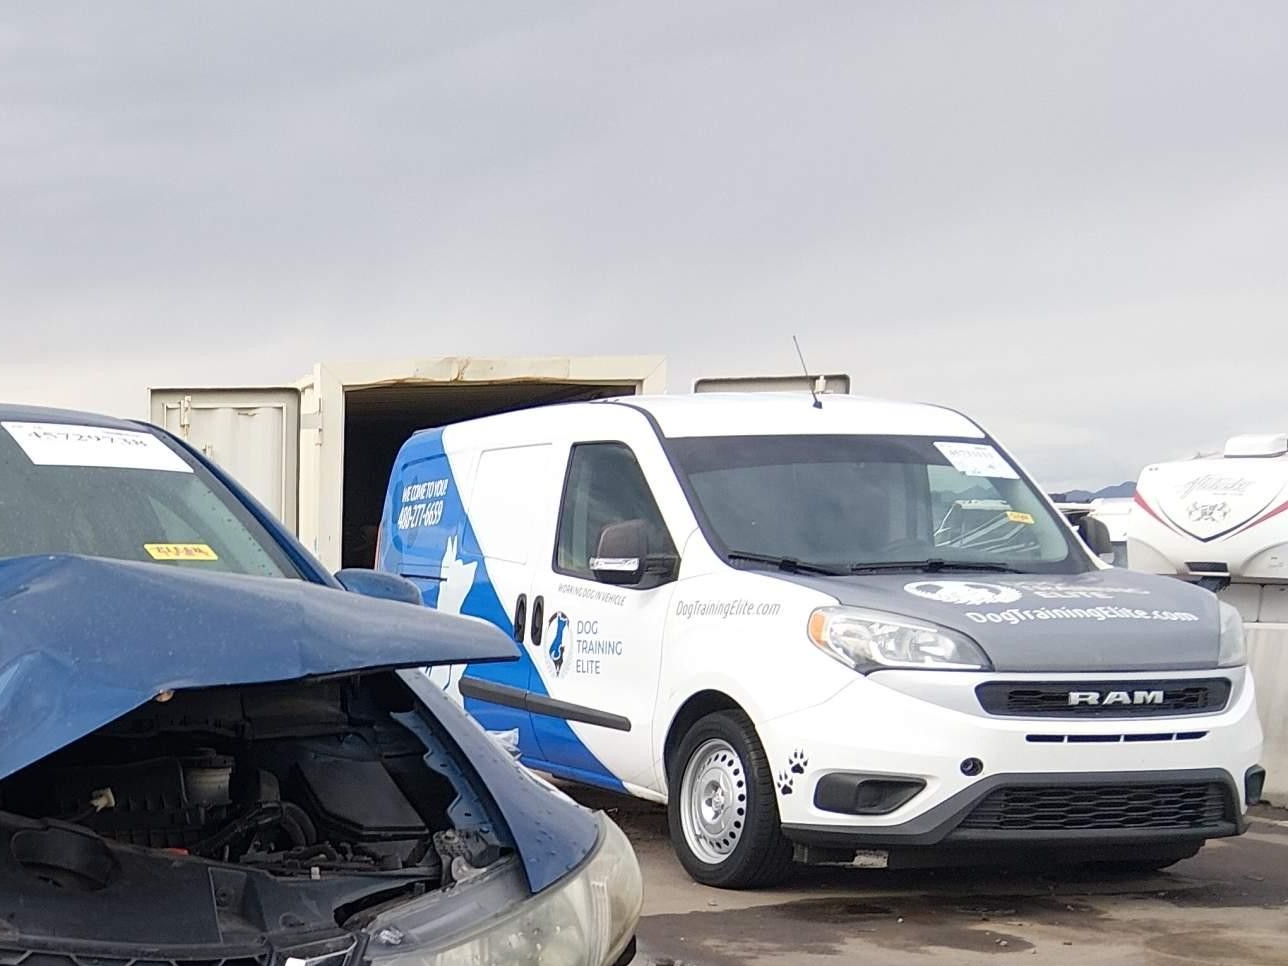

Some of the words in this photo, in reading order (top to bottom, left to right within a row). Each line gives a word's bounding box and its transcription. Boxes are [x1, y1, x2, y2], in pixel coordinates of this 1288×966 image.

[675, 599, 782, 620] DogTrainingElite.com
[966, 606, 1199, 625] DogTrainingElite.com
[576, 620, 599, 635] DOG
[576, 639, 623, 656] TRAINING
[576, 660, 601, 675] ELITE
[1068, 690, 1164, 705] RAM
